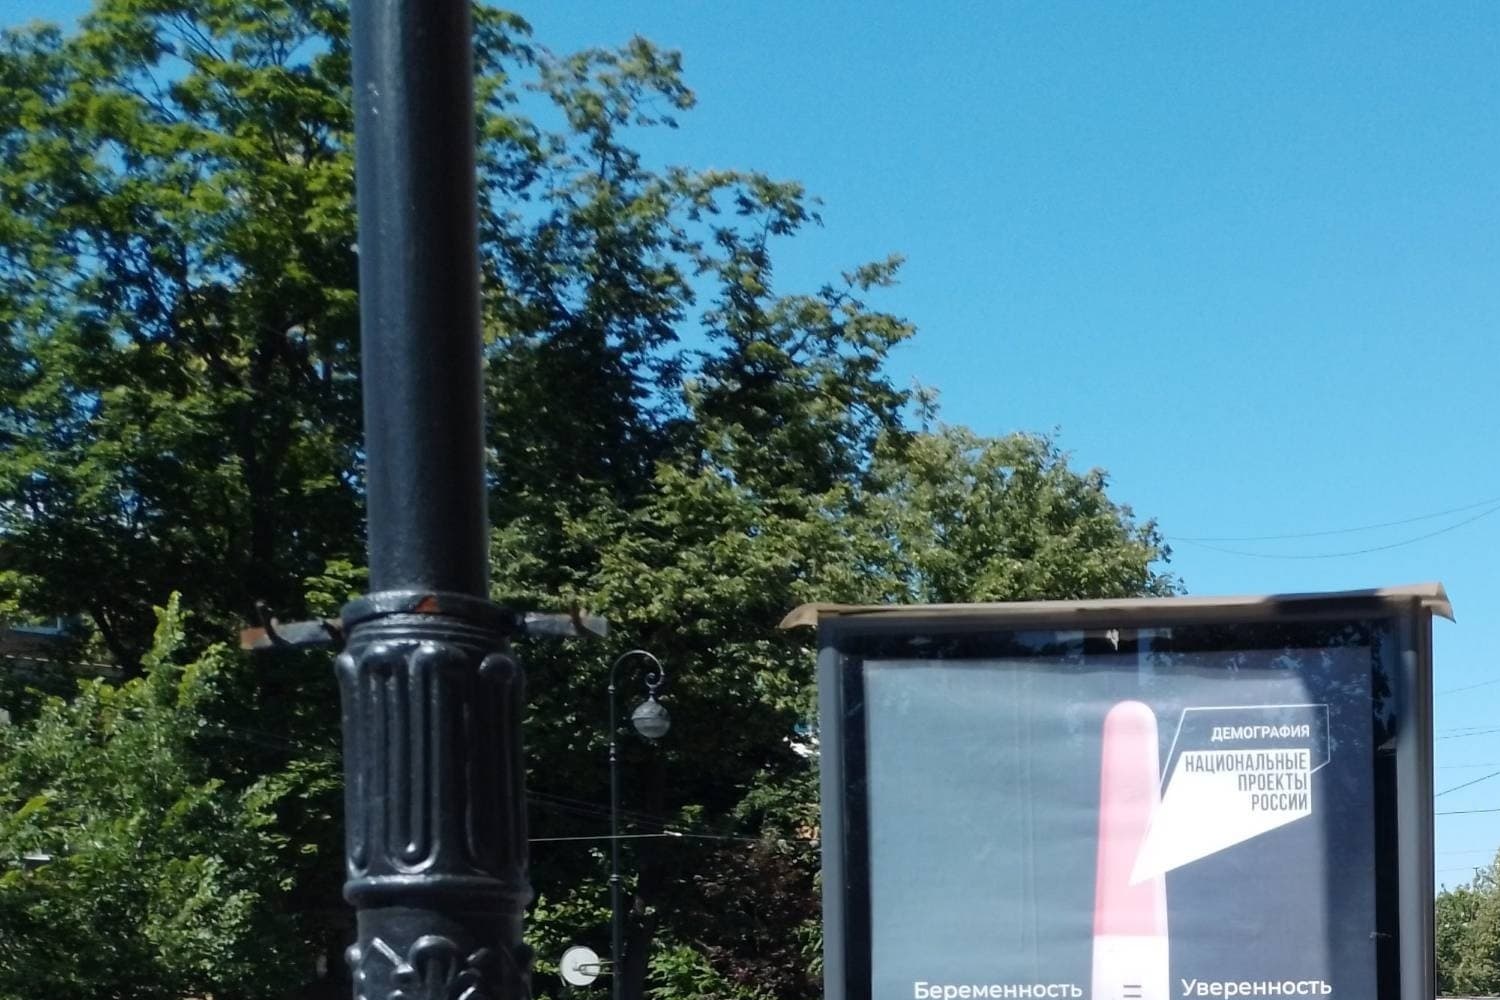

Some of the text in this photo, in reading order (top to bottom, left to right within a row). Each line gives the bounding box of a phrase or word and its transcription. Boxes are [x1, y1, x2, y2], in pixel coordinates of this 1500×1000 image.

[1211, 724, 1310, 742] ДЕМОГРАФИЯ
[1185, 752, 1307, 774] НАЦИОНАЛЬНЫЕ
[1238, 773, 1307, 791] ПРОЕКТЫ
[1251, 793, 1308, 811] РОССИИ
[1181, 978, 1333, 1000] Уверенность
